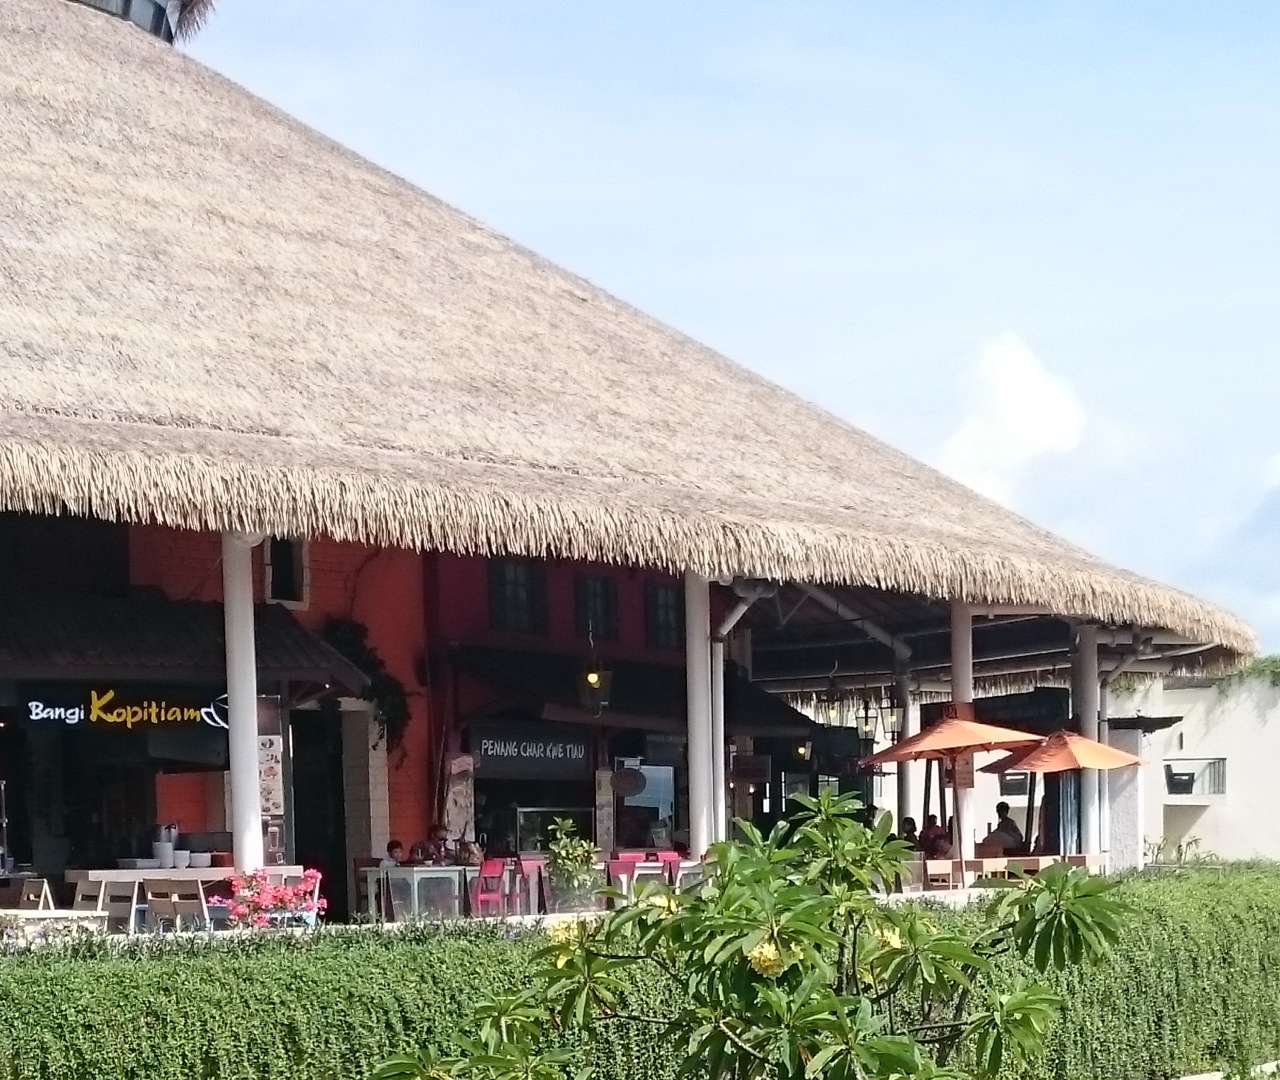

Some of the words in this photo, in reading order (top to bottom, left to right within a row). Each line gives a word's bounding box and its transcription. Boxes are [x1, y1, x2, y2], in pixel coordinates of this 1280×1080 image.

[28, 701, 84, 723] Bangi
[89, 689, 201, 728] Kopitiam
[481, 739, 518, 757] PENANG
[520, 741, 544, 758] CHAR
[566, 743, 585, 759] TIAU
